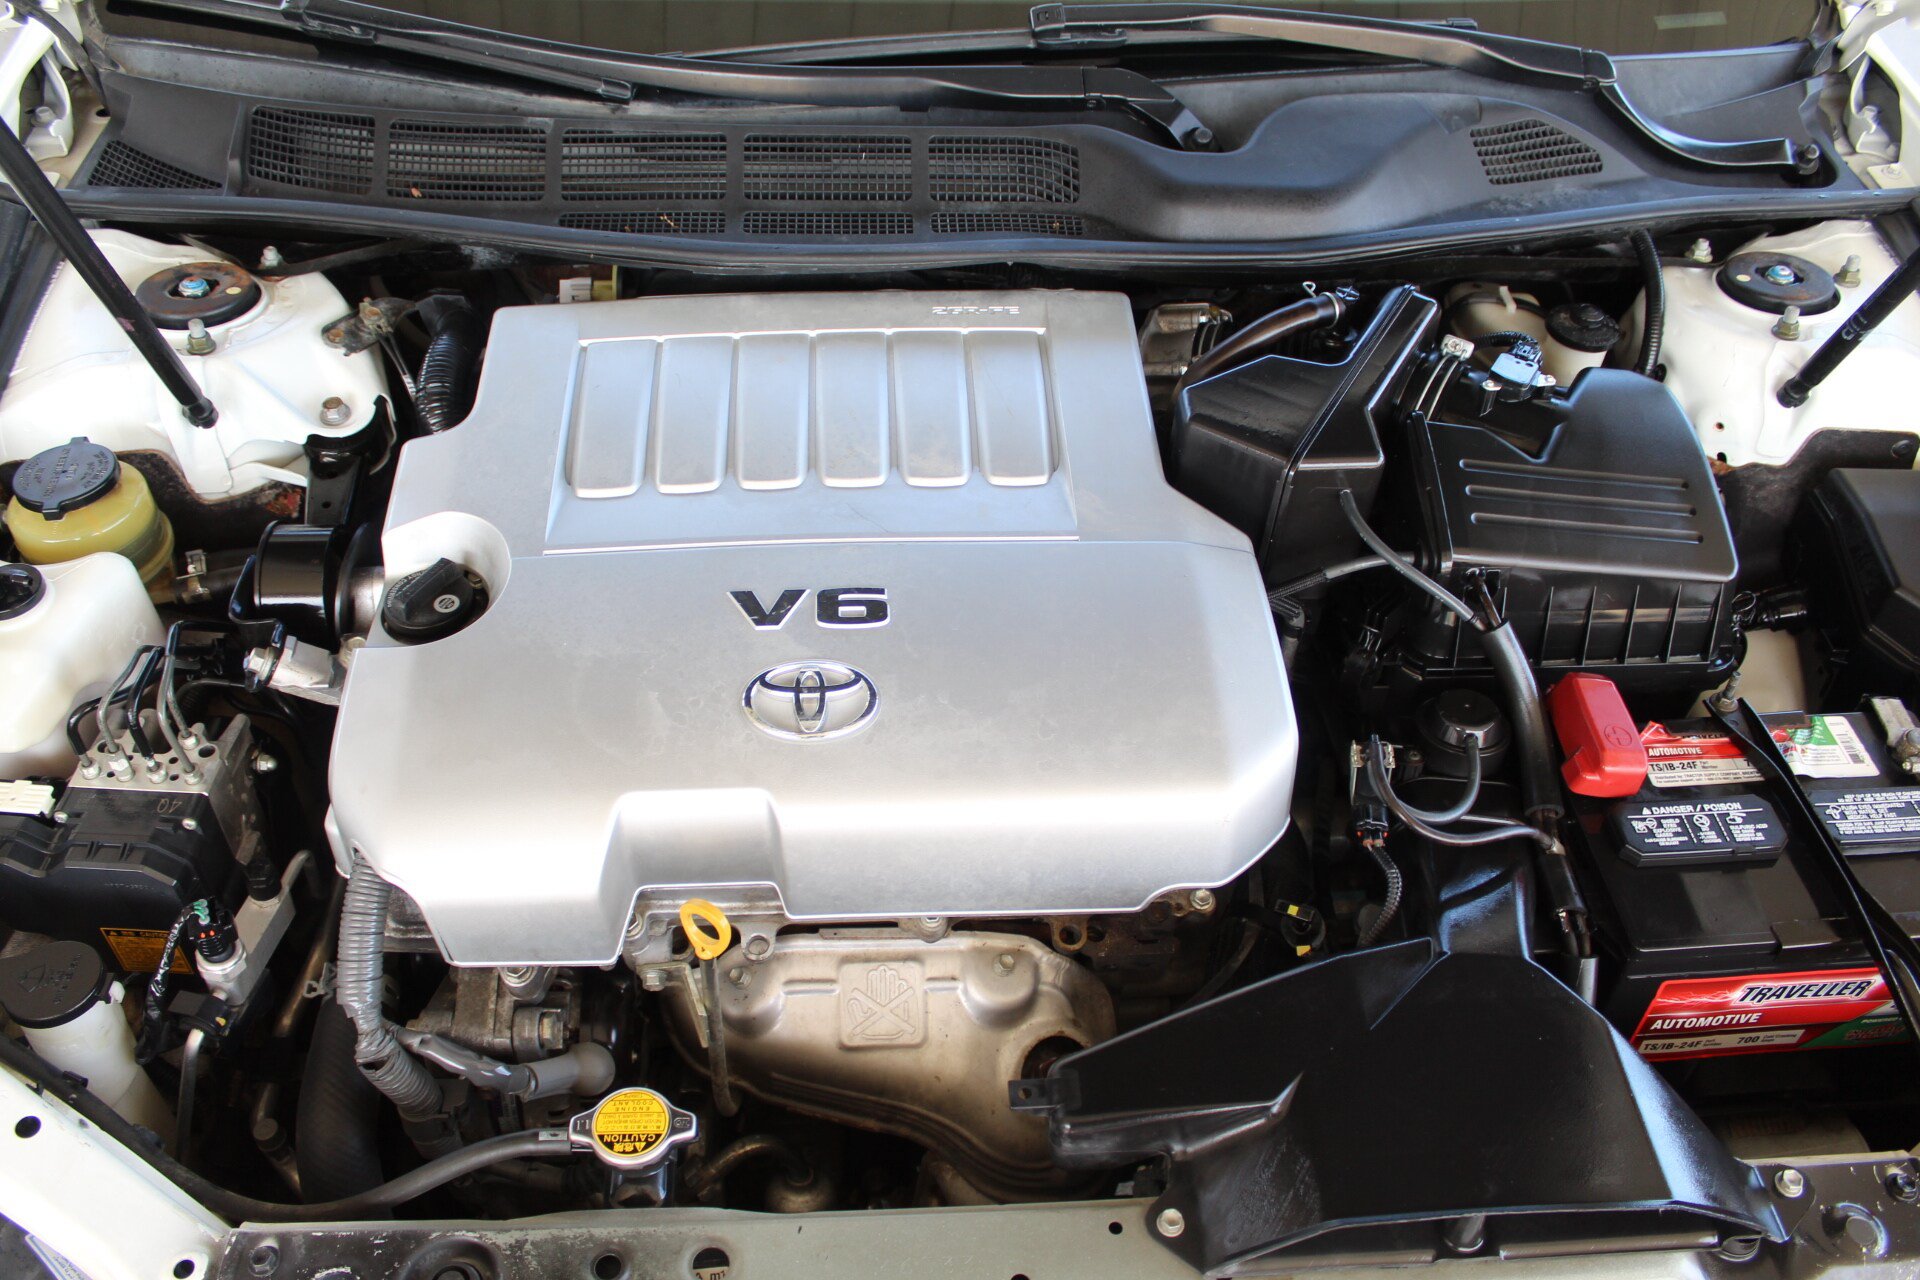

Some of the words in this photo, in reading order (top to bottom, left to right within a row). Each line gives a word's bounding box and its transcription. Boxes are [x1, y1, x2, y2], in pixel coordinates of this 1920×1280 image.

[726, 587, 891, 630] V6
[1648, 747, 1702, 757] AUTOMOTIVE
[1652, 804, 1694, 815] DANGER
[1704, 802, 1742, 811] POISON
[1738, 979, 1876, 1004] TRAVELLER
[1650, 1013, 1762, 1030] AUTOMOTIVE
[1737, 1036, 1760, 1045] 700
[603, 1134, 656, 1142] CAUTION
